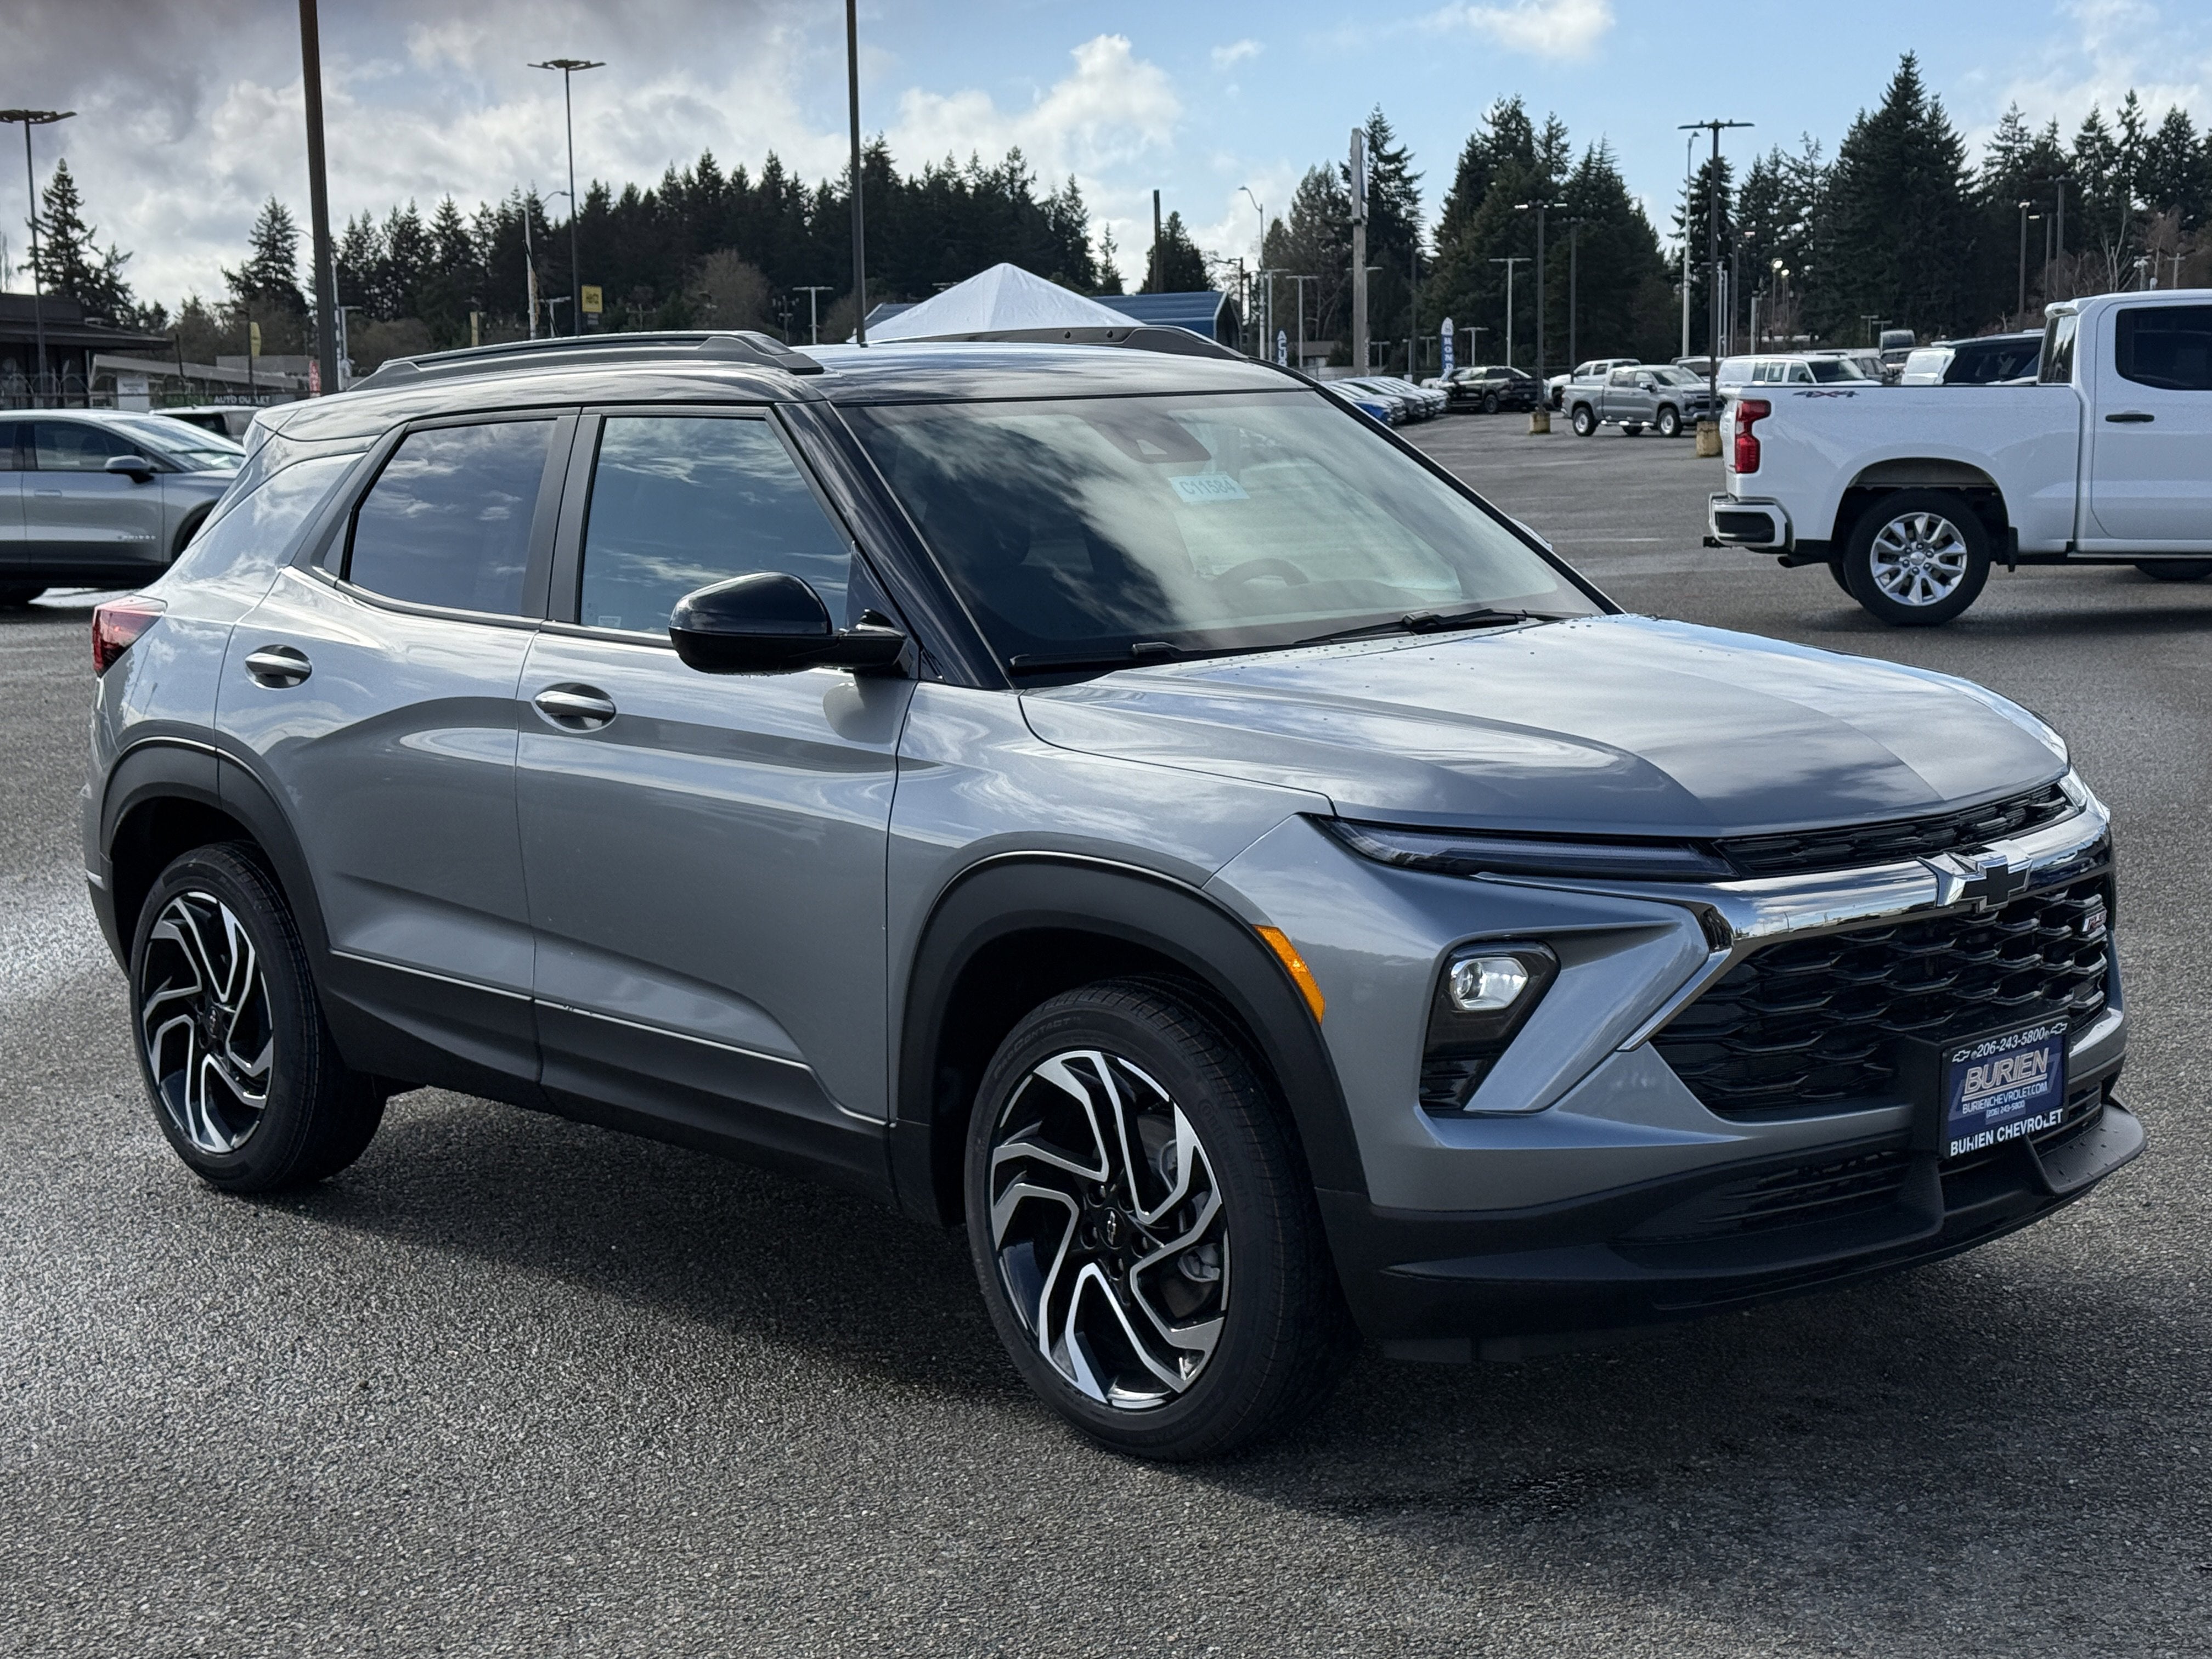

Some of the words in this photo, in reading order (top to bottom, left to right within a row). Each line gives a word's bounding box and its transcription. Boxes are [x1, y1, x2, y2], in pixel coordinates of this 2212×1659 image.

[1277, 330, 1287, 366] ACUR
[214, 395, 237, 404] AUTO
[238, 395, 270, 405] OULET
[1179, 479, 1237, 494] C11584
[2083, 910, 2107, 932] RS
[1976, 1026, 2045, 1058] 206-243-5800
[1965, 1047, 2049, 1094] BURIEN
[1962, 1081, 2048, 1114] BURIENCHEVROLET.COM
[1996, 1108, 2063, 1142] CHEVROLET
